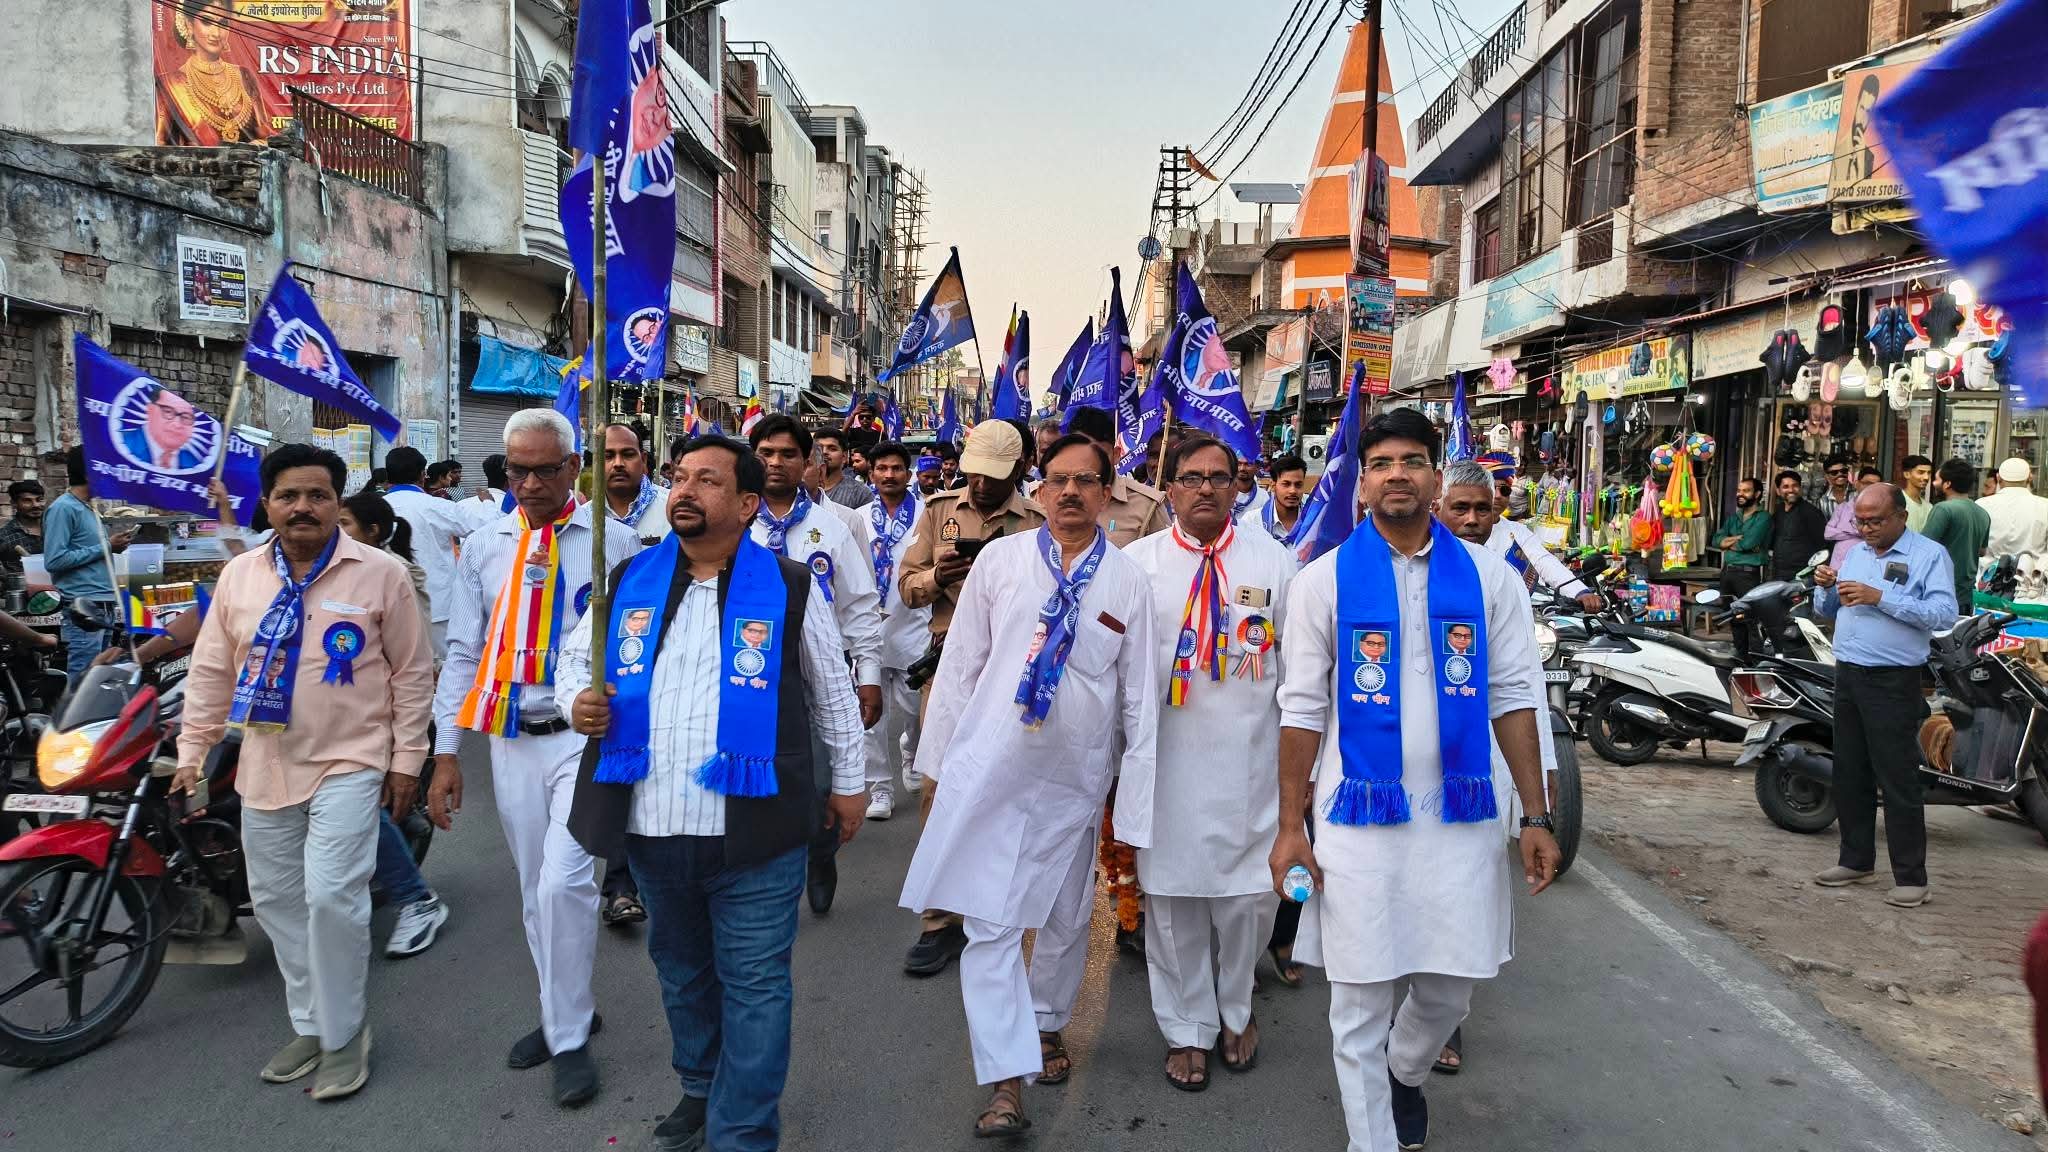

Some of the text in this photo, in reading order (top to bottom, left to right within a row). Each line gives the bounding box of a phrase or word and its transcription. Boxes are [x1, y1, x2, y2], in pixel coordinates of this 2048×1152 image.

[363, 35, 382, 43] Since
[258, 45, 408, 75] RS INDIA
[364, 82, 388, 95] Ltd.
[1857, 185, 1876, 197] SHOE
[1879, 184, 1904, 196] STORE
[230, 254, 243, 267] NDA
[1602, 351, 1622, 369] HAIR
[1184, 391, 1211, 412] जय
[1209, 404, 1246, 432] भारत
[1443, 685, 1476, 697] जय भीम
[1352, 692, 1390, 705] जय भीम
[1938, 777, 1972, 790] HONDA
